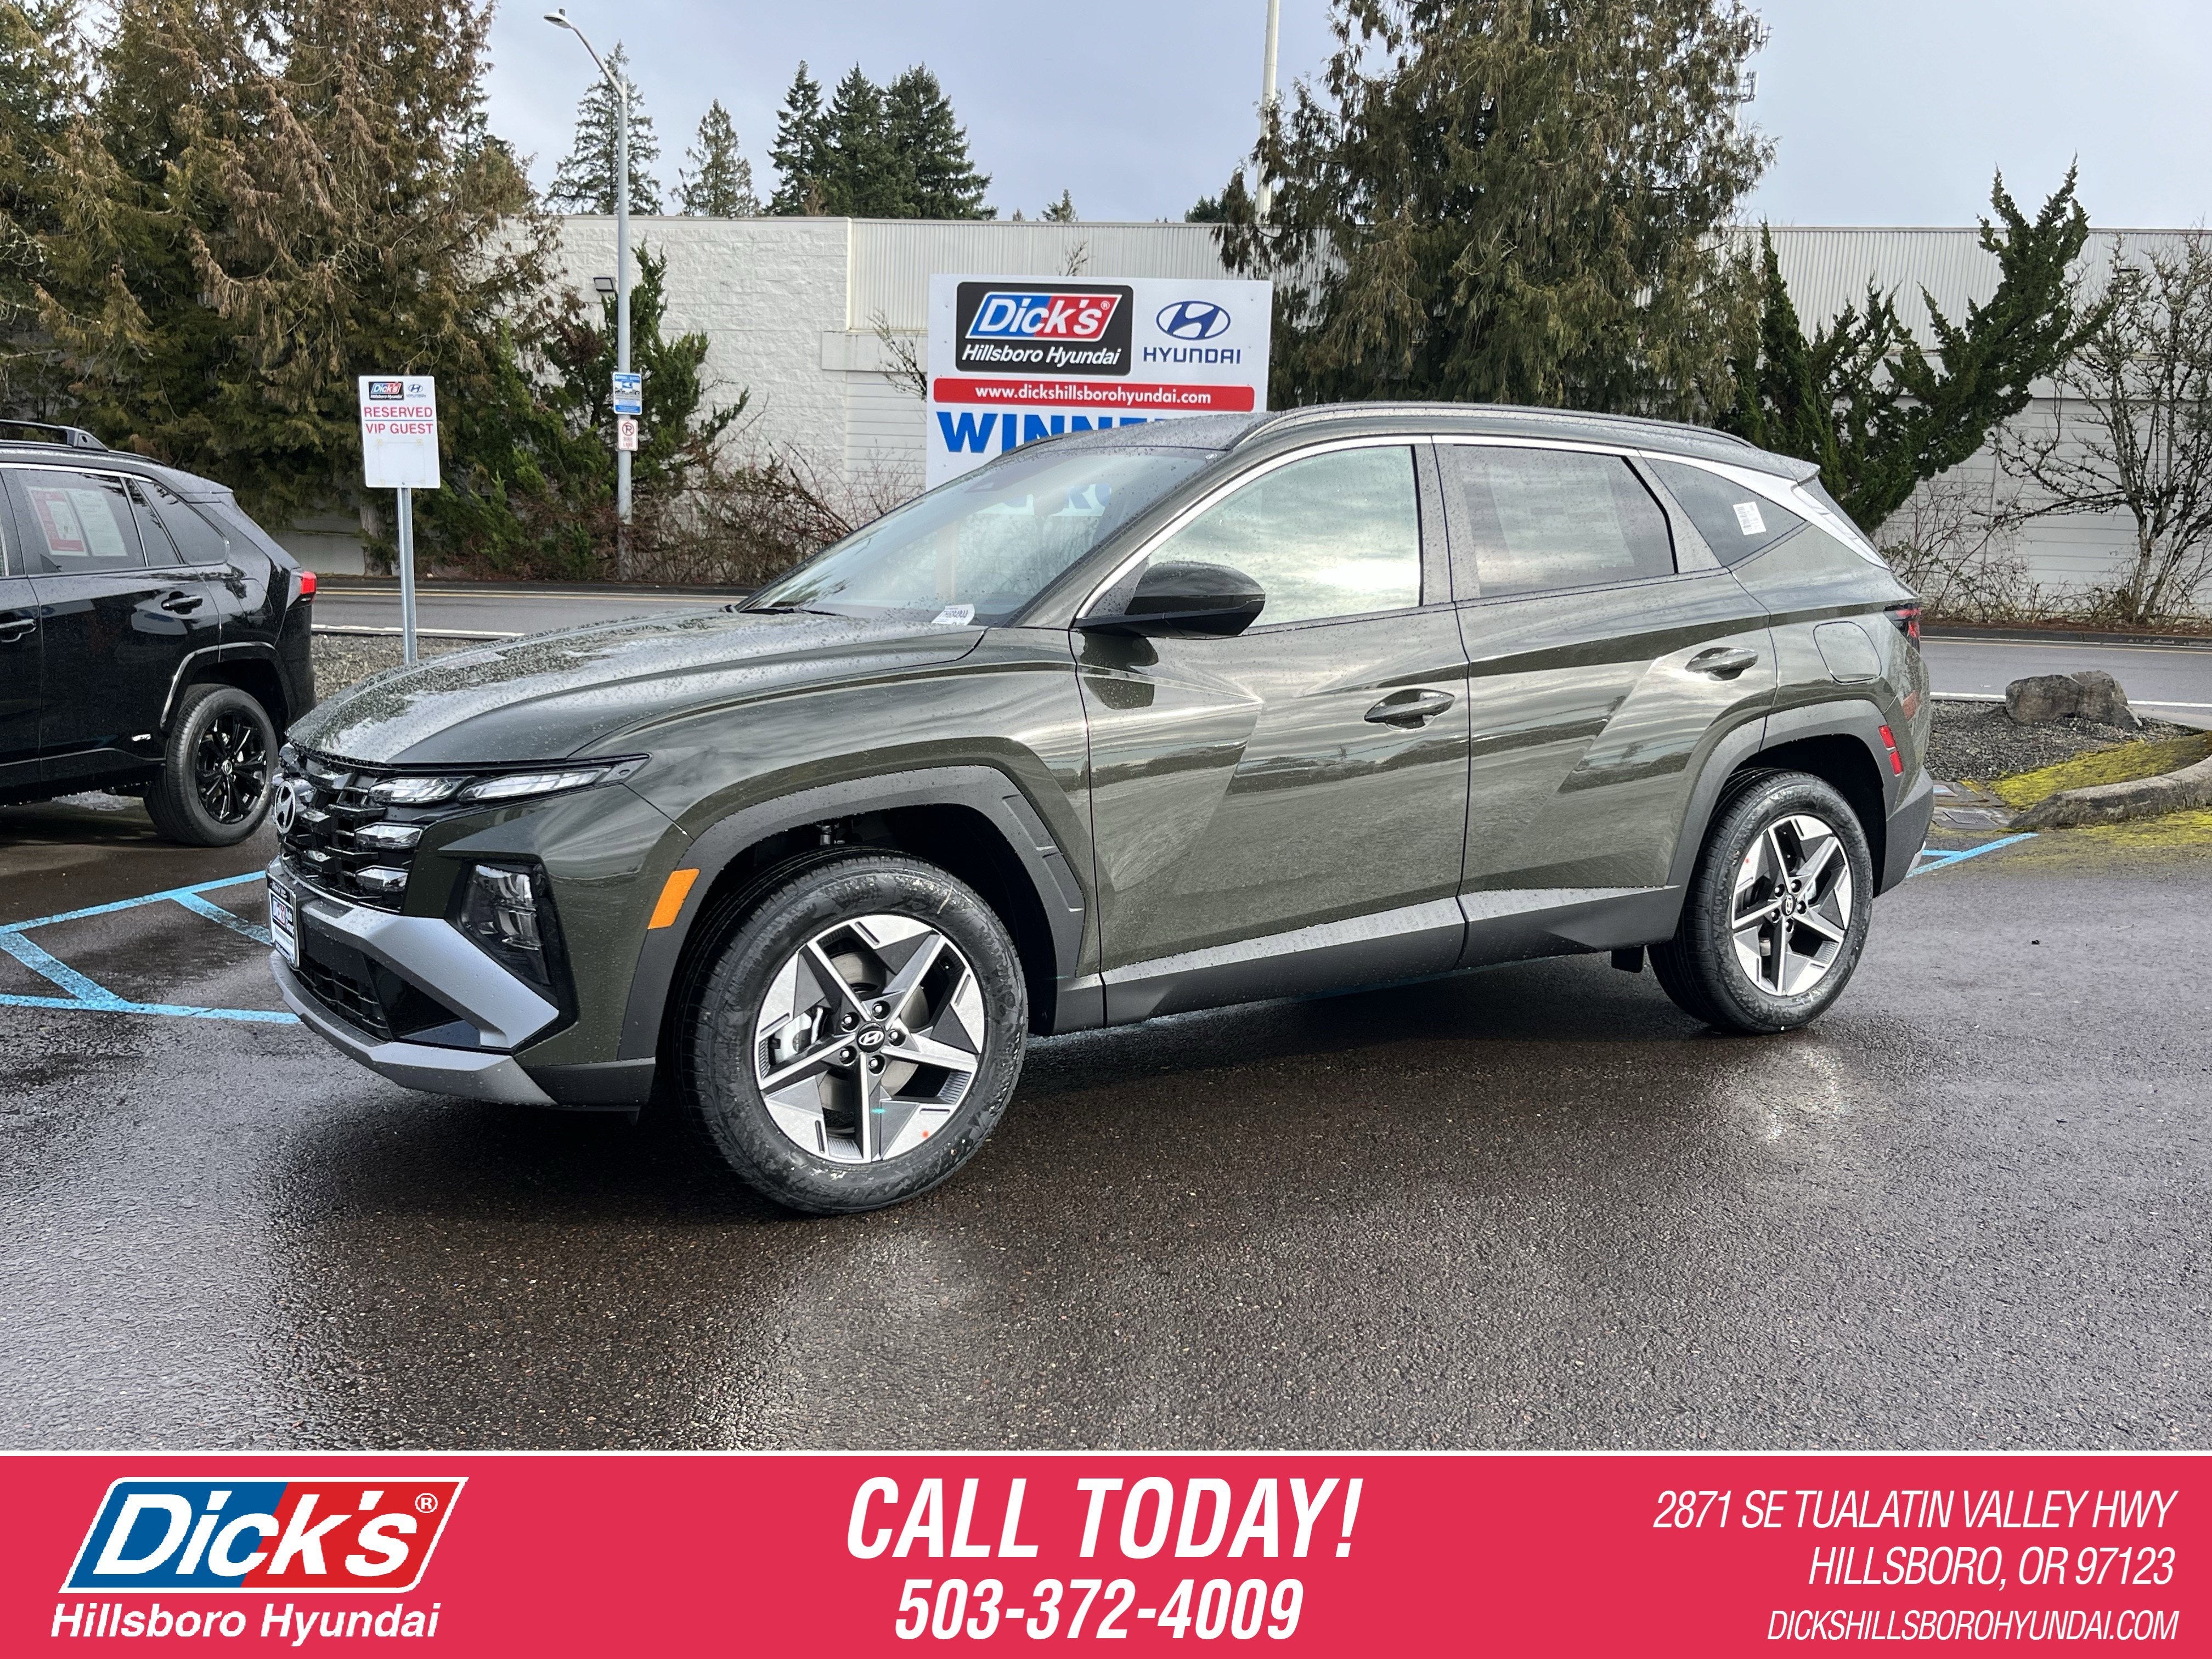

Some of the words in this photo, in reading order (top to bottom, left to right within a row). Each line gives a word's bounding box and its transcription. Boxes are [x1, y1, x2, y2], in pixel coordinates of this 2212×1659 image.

[979, 297, 1102, 335] Dick's
[962, 344, 1043, 363] Hillsboro
[1046, 347, 1122, 368] Hyundai
[1143, 347, 1241, 364] HYUNDAI
[975, 386, 1211, 405] www.dickshillsborohyundai.com
[364, 407, 433, 417] RESERVED
[365, 423, 386, 433] VIP
[390, 423, 433, 434] GUEST
